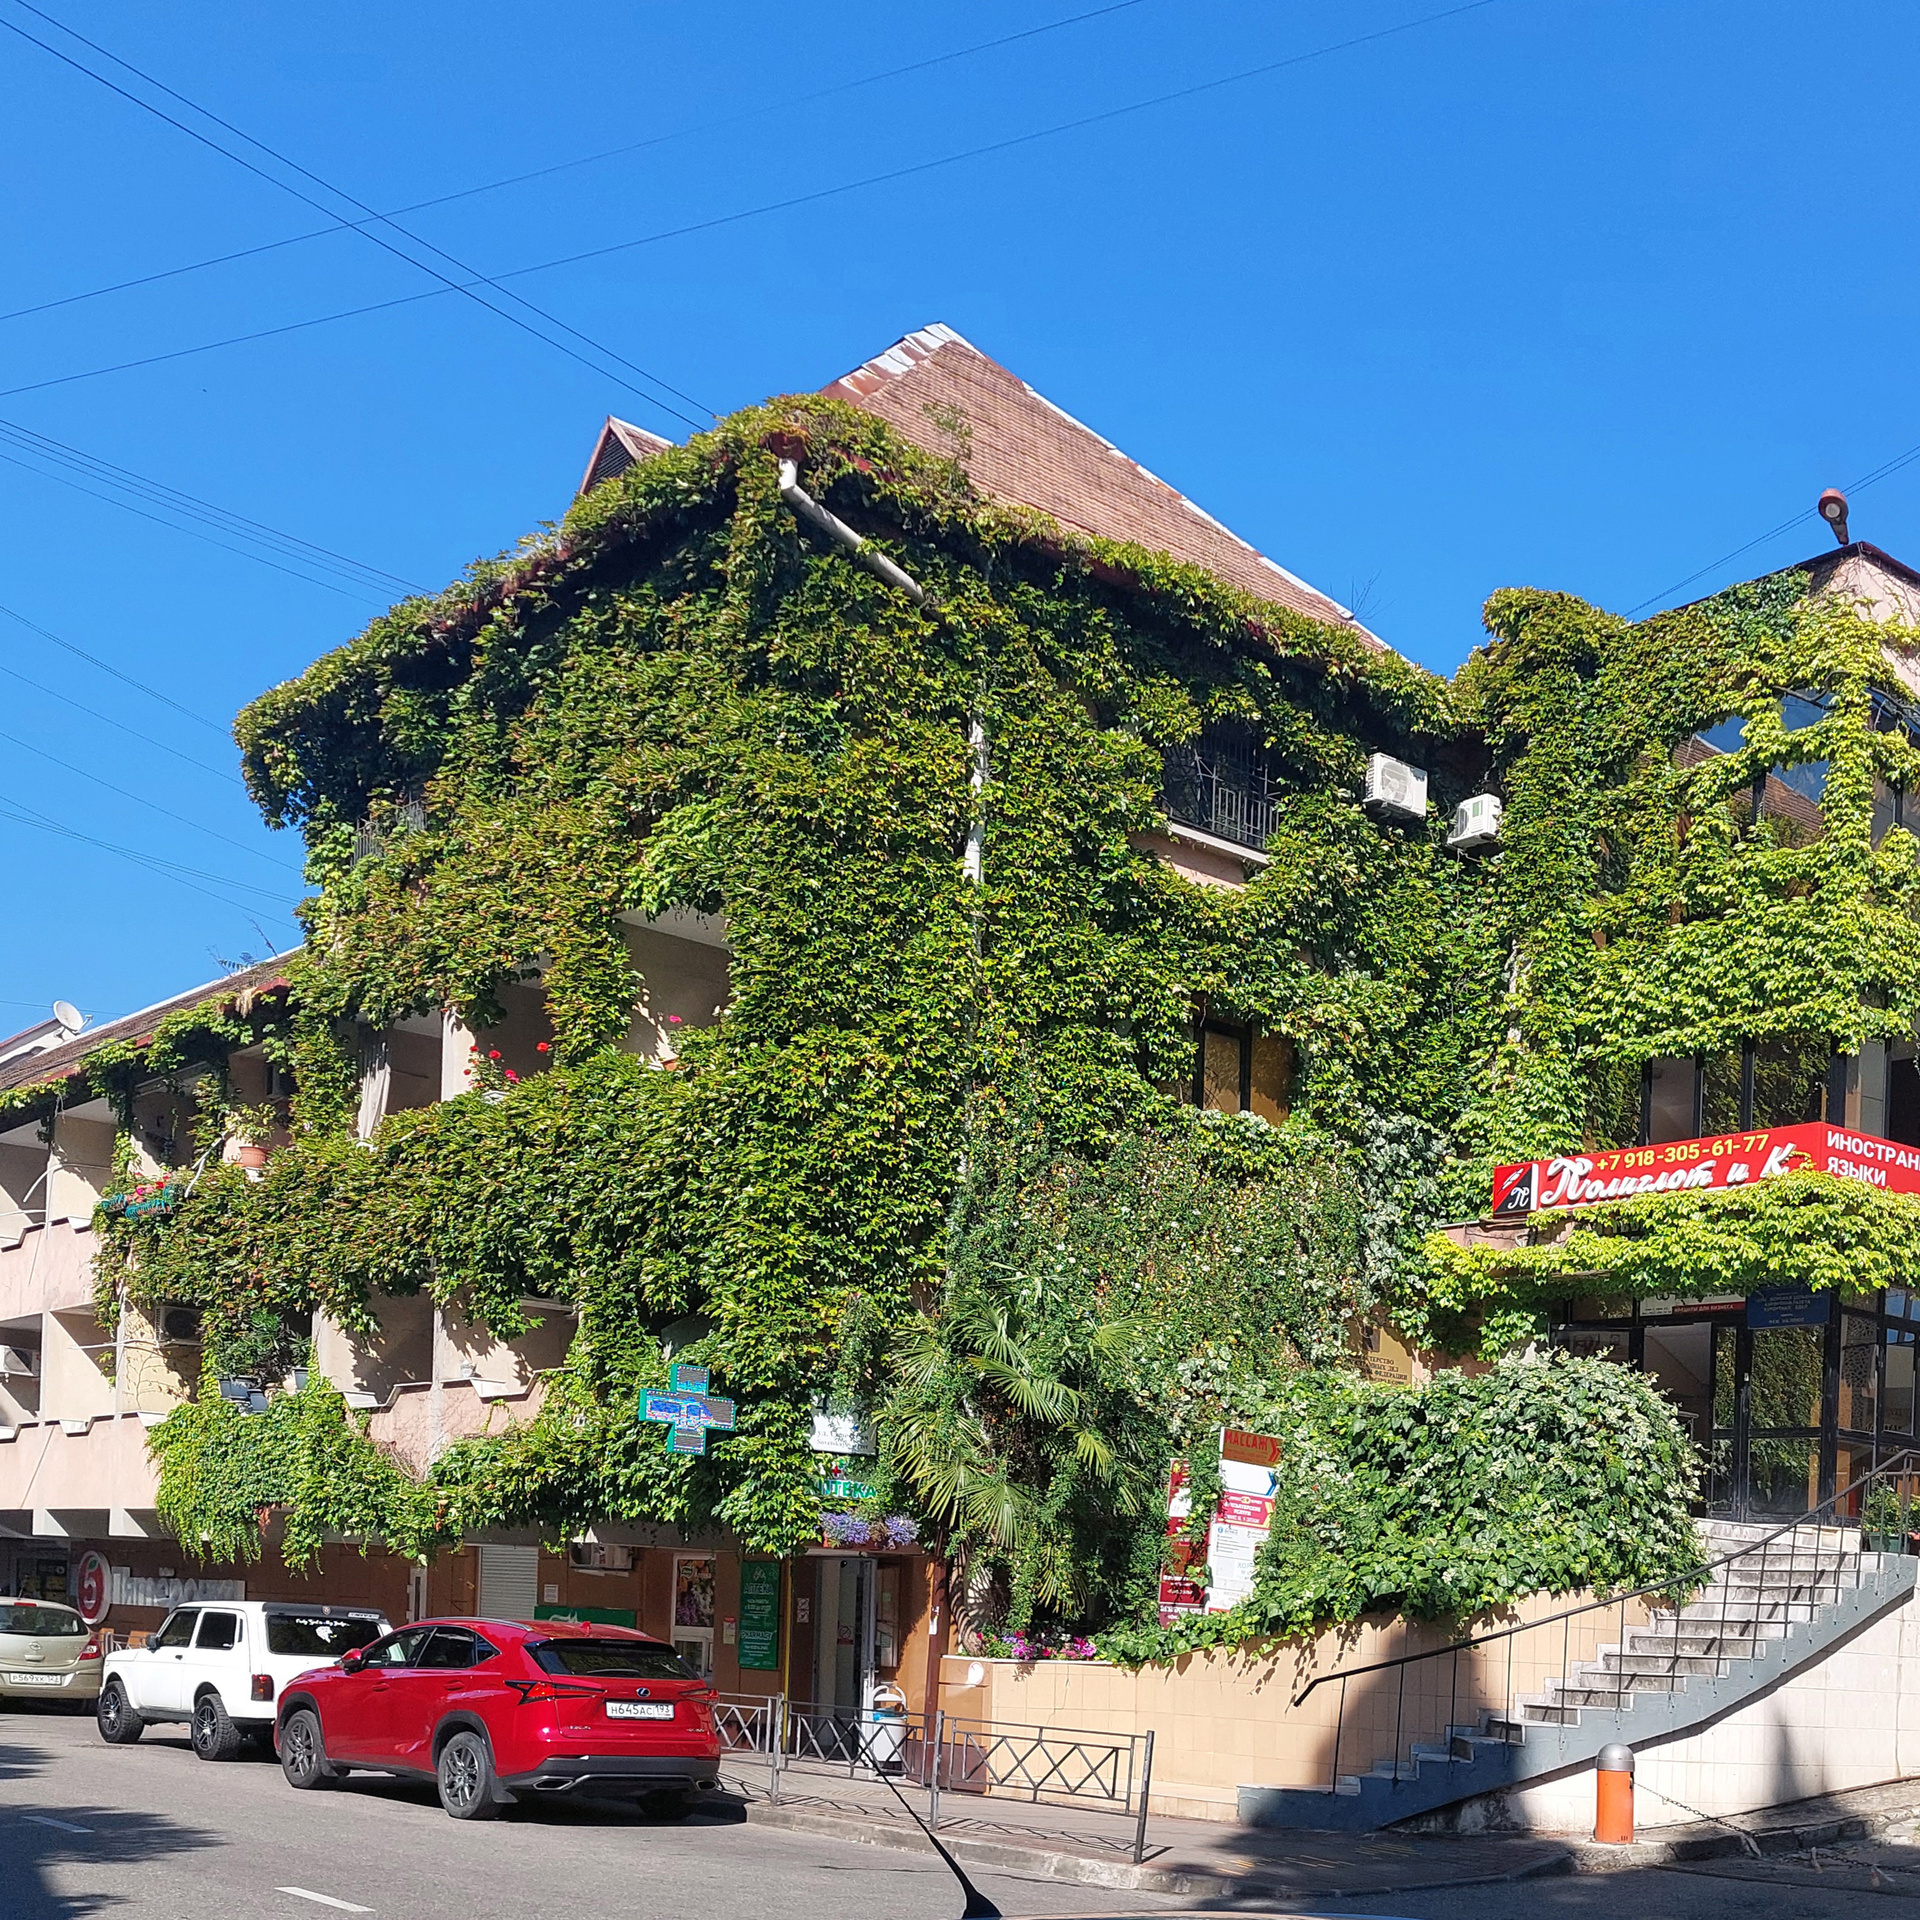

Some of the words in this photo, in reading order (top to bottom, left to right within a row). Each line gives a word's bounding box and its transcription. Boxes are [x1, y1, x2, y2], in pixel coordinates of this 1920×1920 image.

[1596, 1154, 1620, 1171] +7
[1624, 1134, 1769, 1169] 918-305-61-77
[1827, 1130, 1920, 1172] ИНОСТРАН
[1540, 1156, 1717, 1205] Полиглот
[1726, 1162, 1750, 1184] и
[1827, 1157, 1887, 1187] ЯЗЫКИ
[1224, 1429, 1268, 1451] МАССАЖ
[743, 1582, 774, 1595] АПТЕКА
[611, 1704, 653, 1716] Н645АС
[655, 1704, 670, 1714] 193
